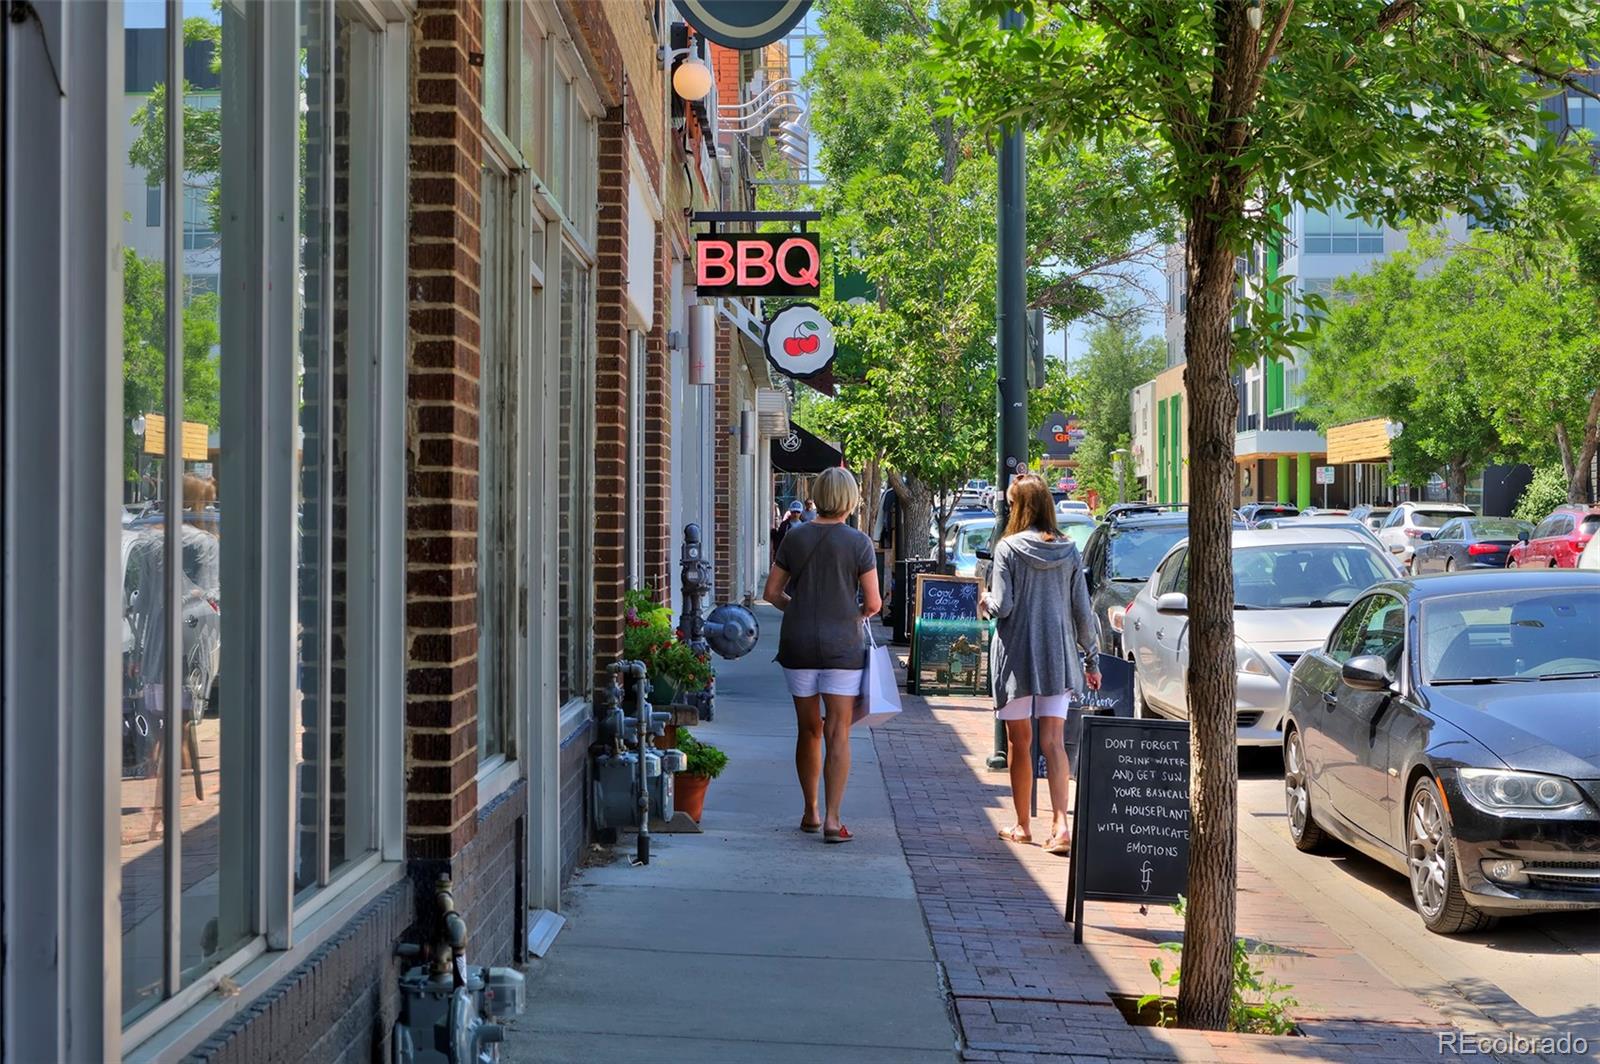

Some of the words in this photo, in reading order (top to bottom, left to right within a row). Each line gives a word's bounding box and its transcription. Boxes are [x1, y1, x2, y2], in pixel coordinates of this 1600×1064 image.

[697, 237, 820, 288] BBQ
[928, 587, 954, 599] Cool
[1105, 738, 1134, 749] DON'T
[1141, 740, 1180, 750] FORGET
[1118, 755, 1150, 765] DRINK
[1156, 757, 1188, 767] WATER
[1112, 769, 1134, 782] AND
[1137, 770, 1156, 780] GET
[1163, 772, 1186, 783] SUN.
[1146, 787, 1190, 799] BASICALL
[1111, 803, 1118, 814] A
[1125, 805, 1190, 820] HOUSEPLANT
[1097, 823, 1124, 833] WITH
[1130, 824, 1190, 840] COMPLICATE
[1126, 842, 1178, 857] EMOTIONS
